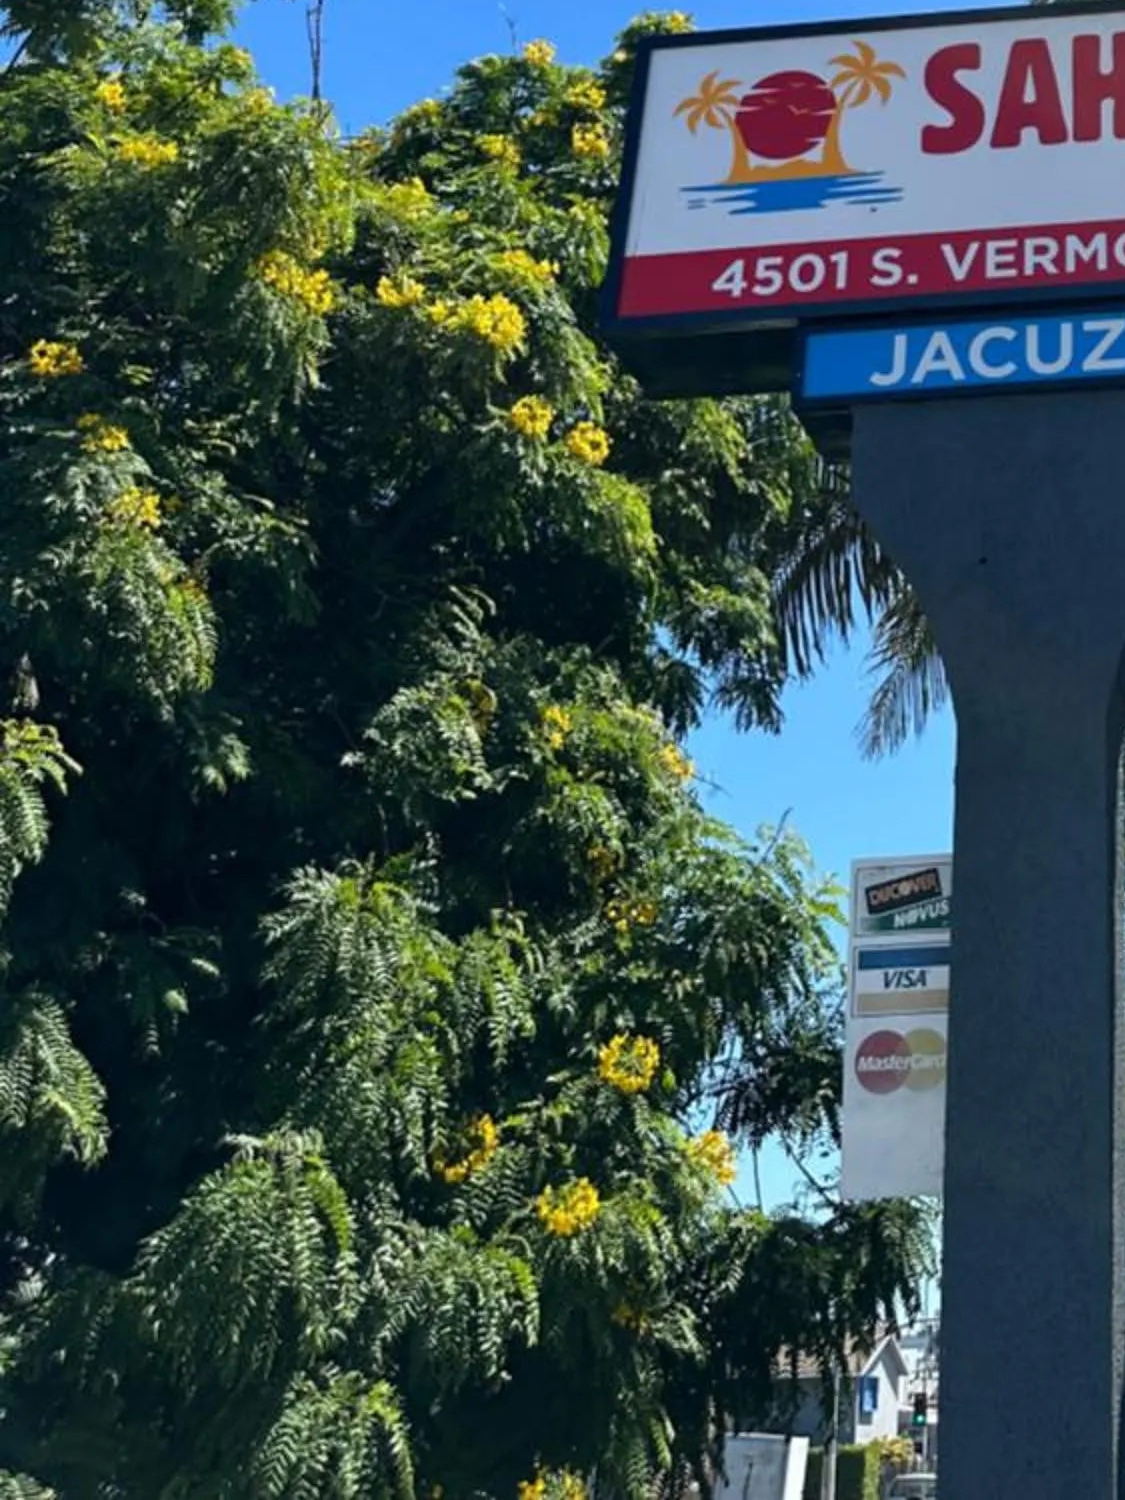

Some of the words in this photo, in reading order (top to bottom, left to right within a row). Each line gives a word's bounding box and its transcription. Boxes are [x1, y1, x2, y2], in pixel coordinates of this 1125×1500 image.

[712, 251, 848, 297] 4501
[870, 249, 919, 287] S.
[882, 970, 927, 989] VISA
